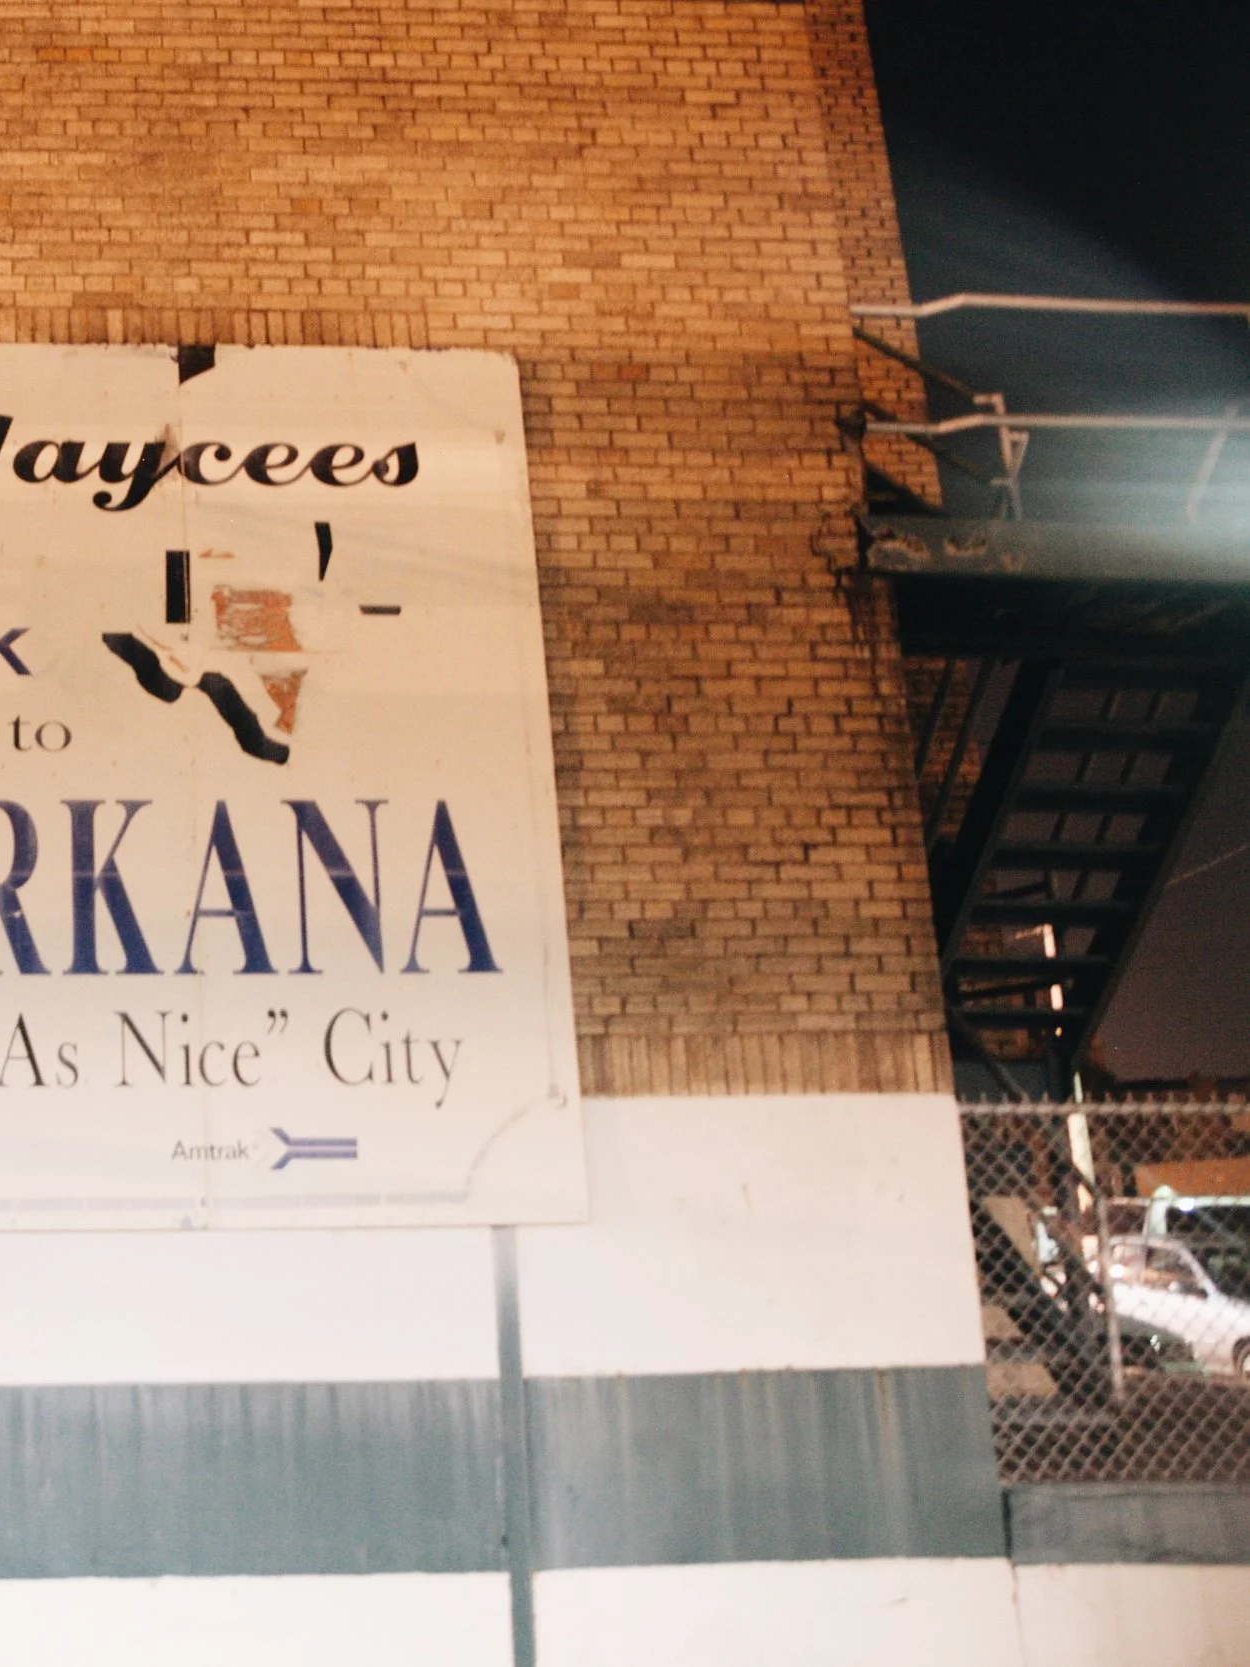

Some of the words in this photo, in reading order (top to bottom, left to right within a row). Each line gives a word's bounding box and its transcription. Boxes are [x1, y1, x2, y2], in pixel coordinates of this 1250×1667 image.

[8, 715, 72, 753] to
[114, 1009, 288, 1087] Nice”
[324, 1007, 464, 1108] City
[171, 1140, 250, 1161] Amtrak
